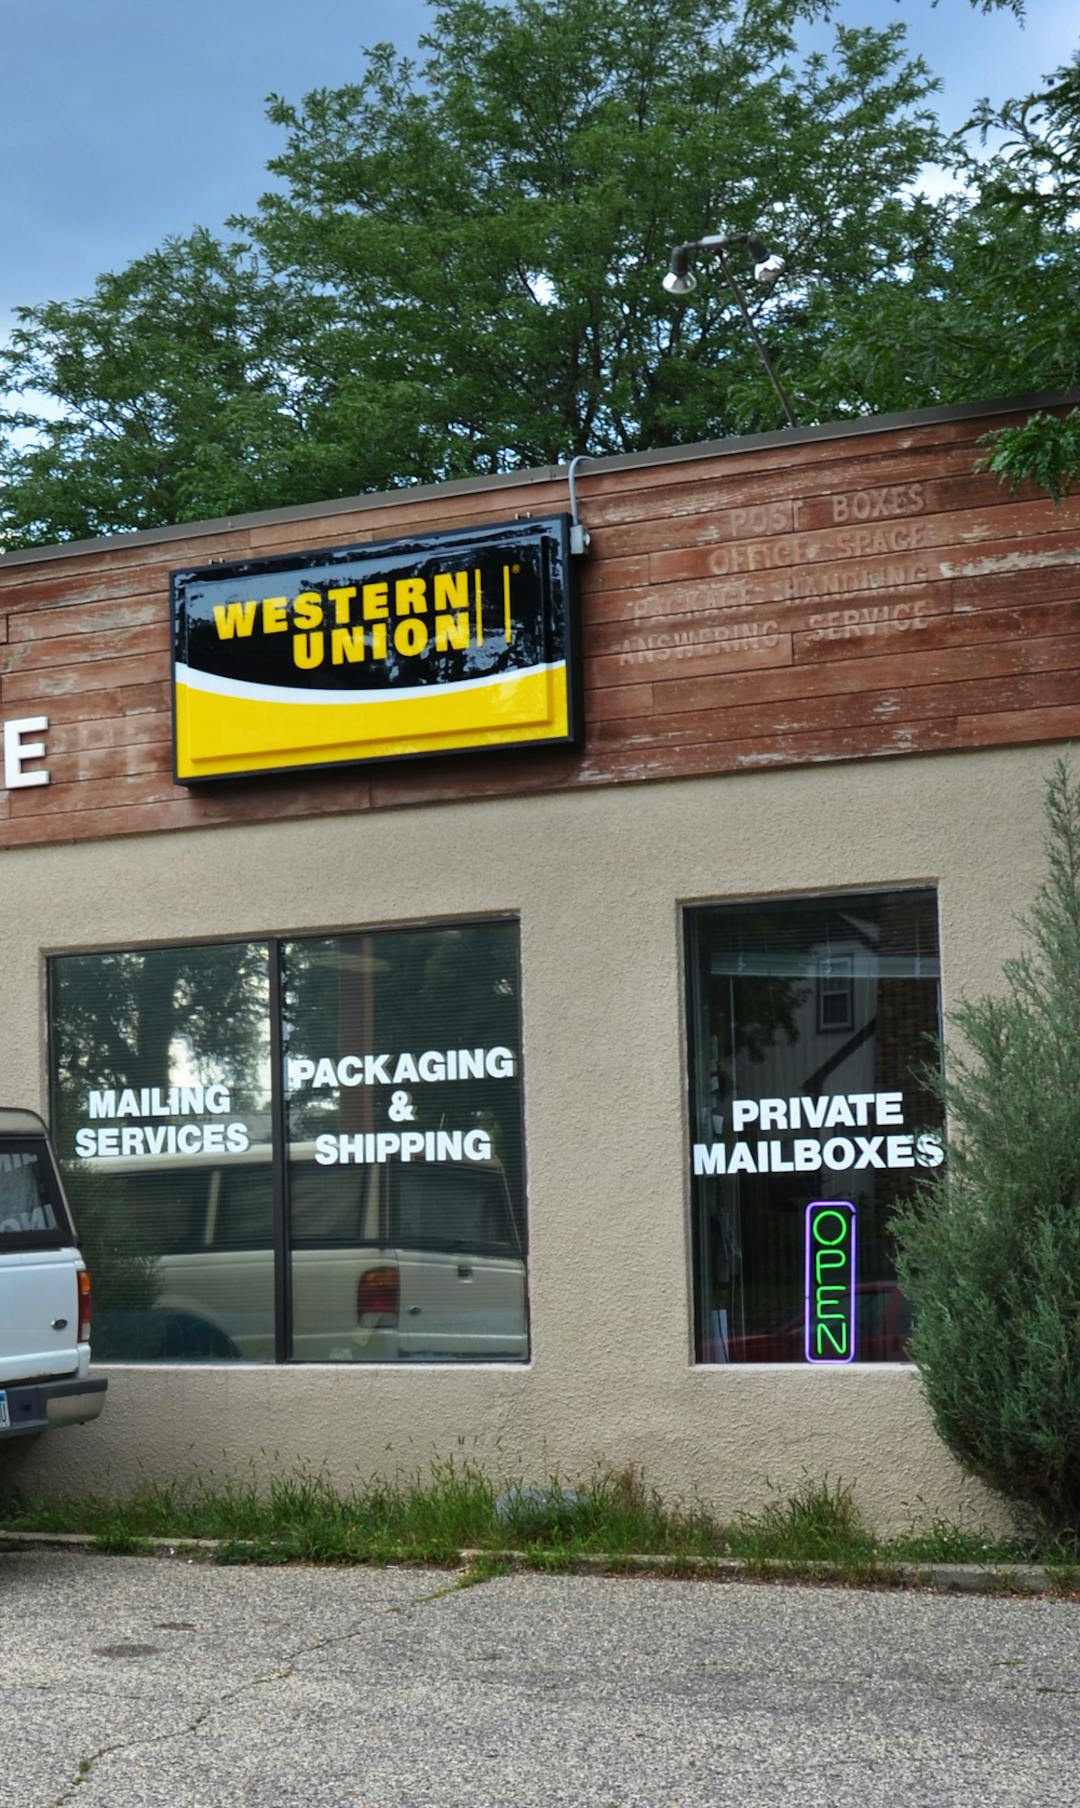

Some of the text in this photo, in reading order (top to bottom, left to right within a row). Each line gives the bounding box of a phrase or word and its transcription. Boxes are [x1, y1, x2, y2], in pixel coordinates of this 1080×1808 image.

[728, 482, 926, 537] POST BOXES
[707, 522, 925, 576] OFFICE SPACE
[212, 570, 469, 641] WESTERN
[292, 611, 470, 670] UNION
[620, 600, 929, 667] ANSWERING SERVICE
[292, 1046, 515, 1089] PACKAGING
[88, 1084, 231, 1119] MAILING
[388, 1090, 415, 1122] &
[732, 1092, 904, 1132] PRIVATE
[75, 1122, 250, 1158] SERVICES
[314, 1129, 493, 1166] SHIPPING
[693, 1133, 946, 1176] MAILBOXES
[812, 1209, 848, 1355] OPEN
